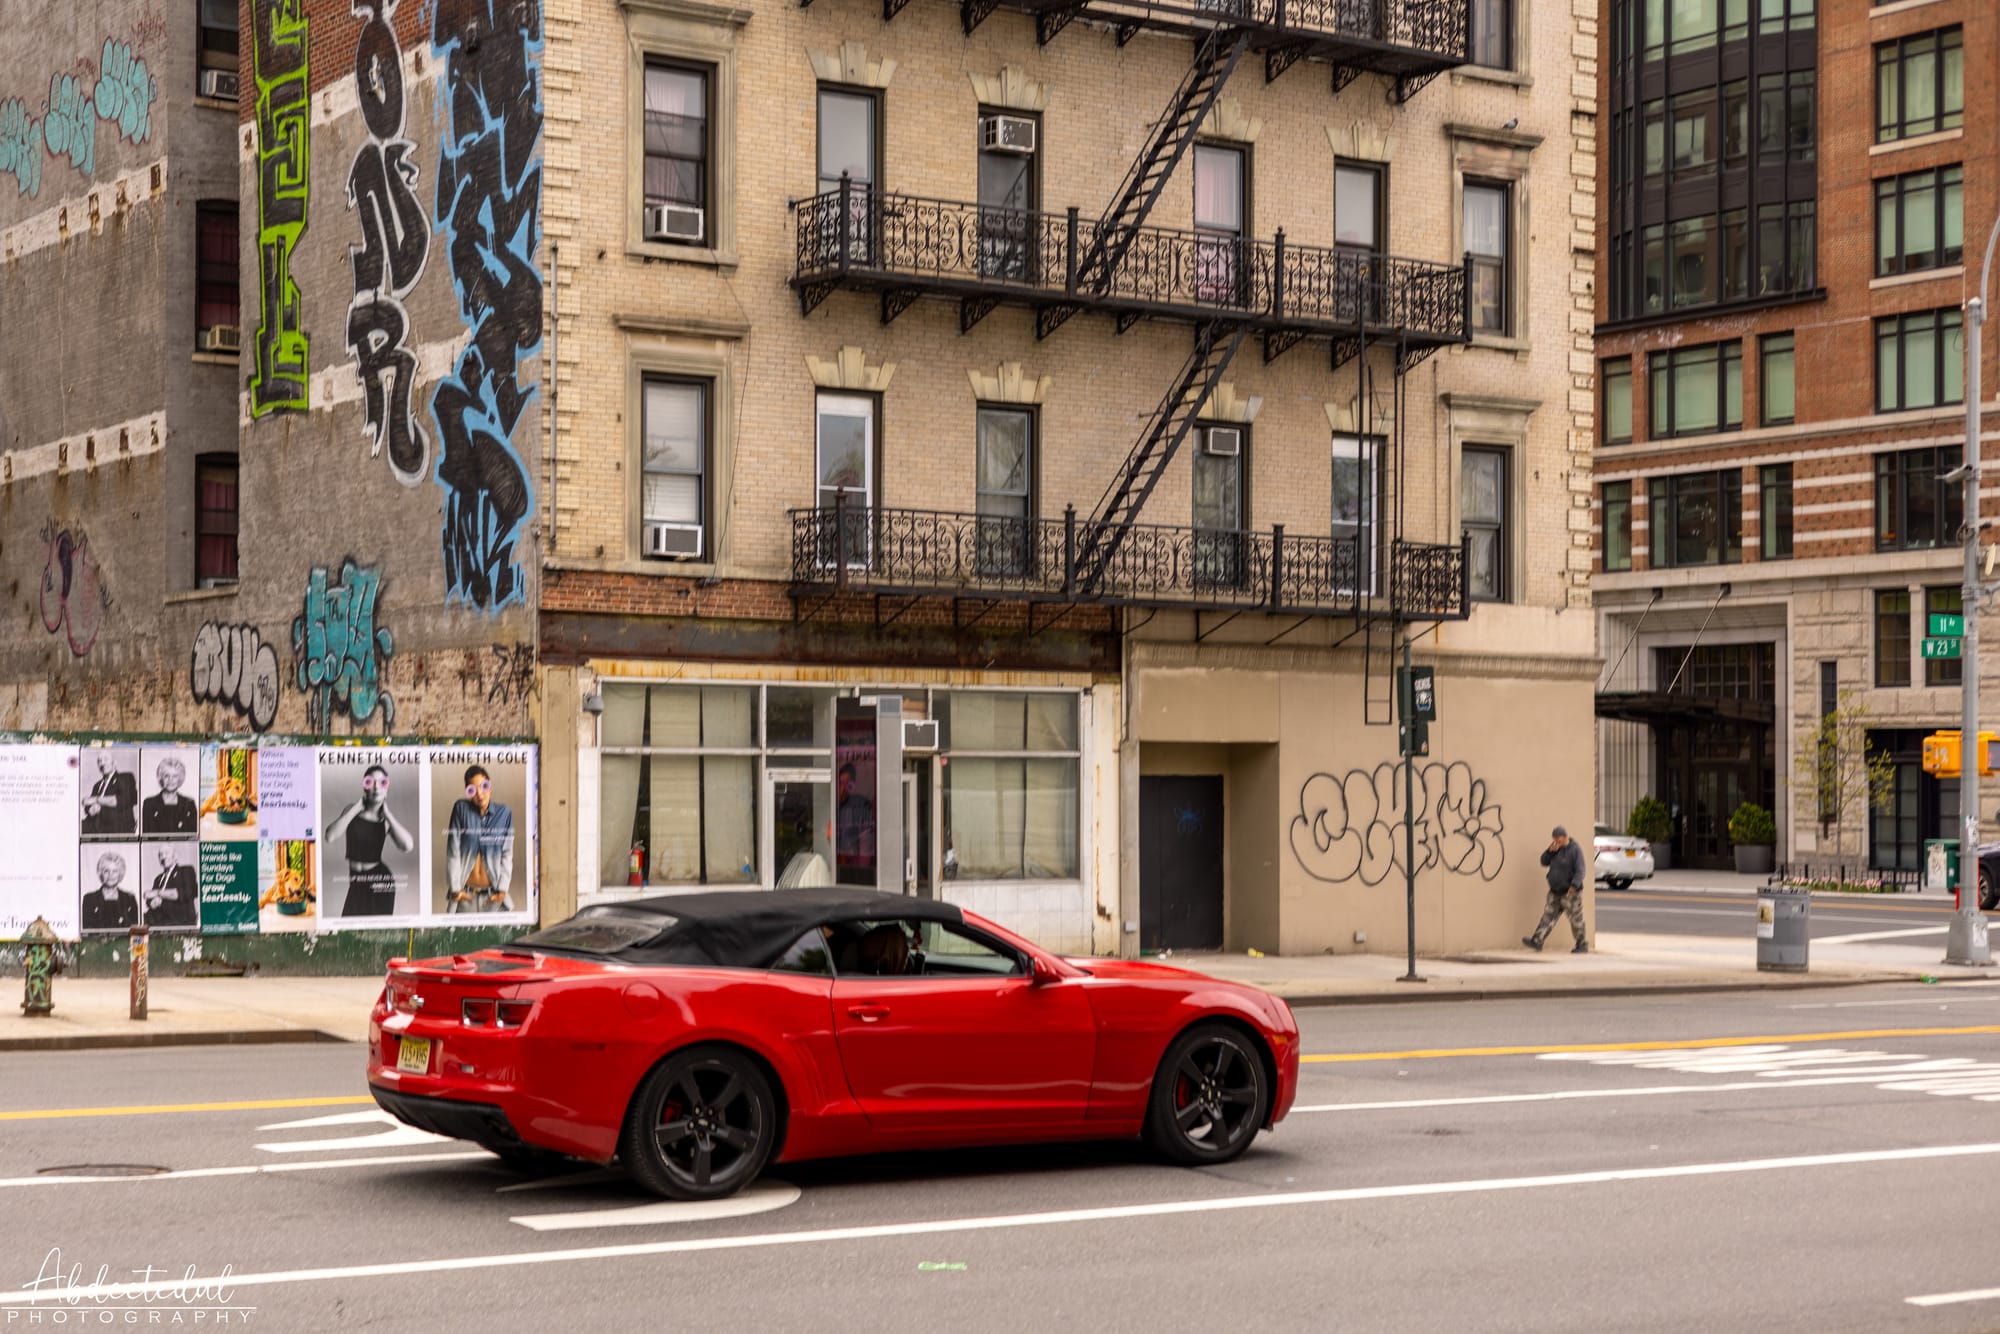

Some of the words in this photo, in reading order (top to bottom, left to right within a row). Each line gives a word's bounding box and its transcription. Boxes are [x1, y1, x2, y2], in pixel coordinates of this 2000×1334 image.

[1940, 617, 1947, 633] 11
[1927, 639, 1935, 657] W
[1937, 639, 1948, 656] 23
[318, 751, 384, 765] KENNETH
[388, 751, 421, 765] COLE
[429, 751, 491, 765] KENNETH
[497, 751, 529, 765] COLE
[260, 771, 292, 781] Sundays
[274, 781, 293, 790] Dogs
[260, 791, 284, 800] grow
[201, 843, 227, 853] Where
[201, 853, 228, 863] brands
[228, 852, 243, 863] like
[201, 863, 234, 874] Sundays
[201, 873, 214, 883] For
[215, 873, 236, 884] Dogs
[201, 884, 226, 894] grow
